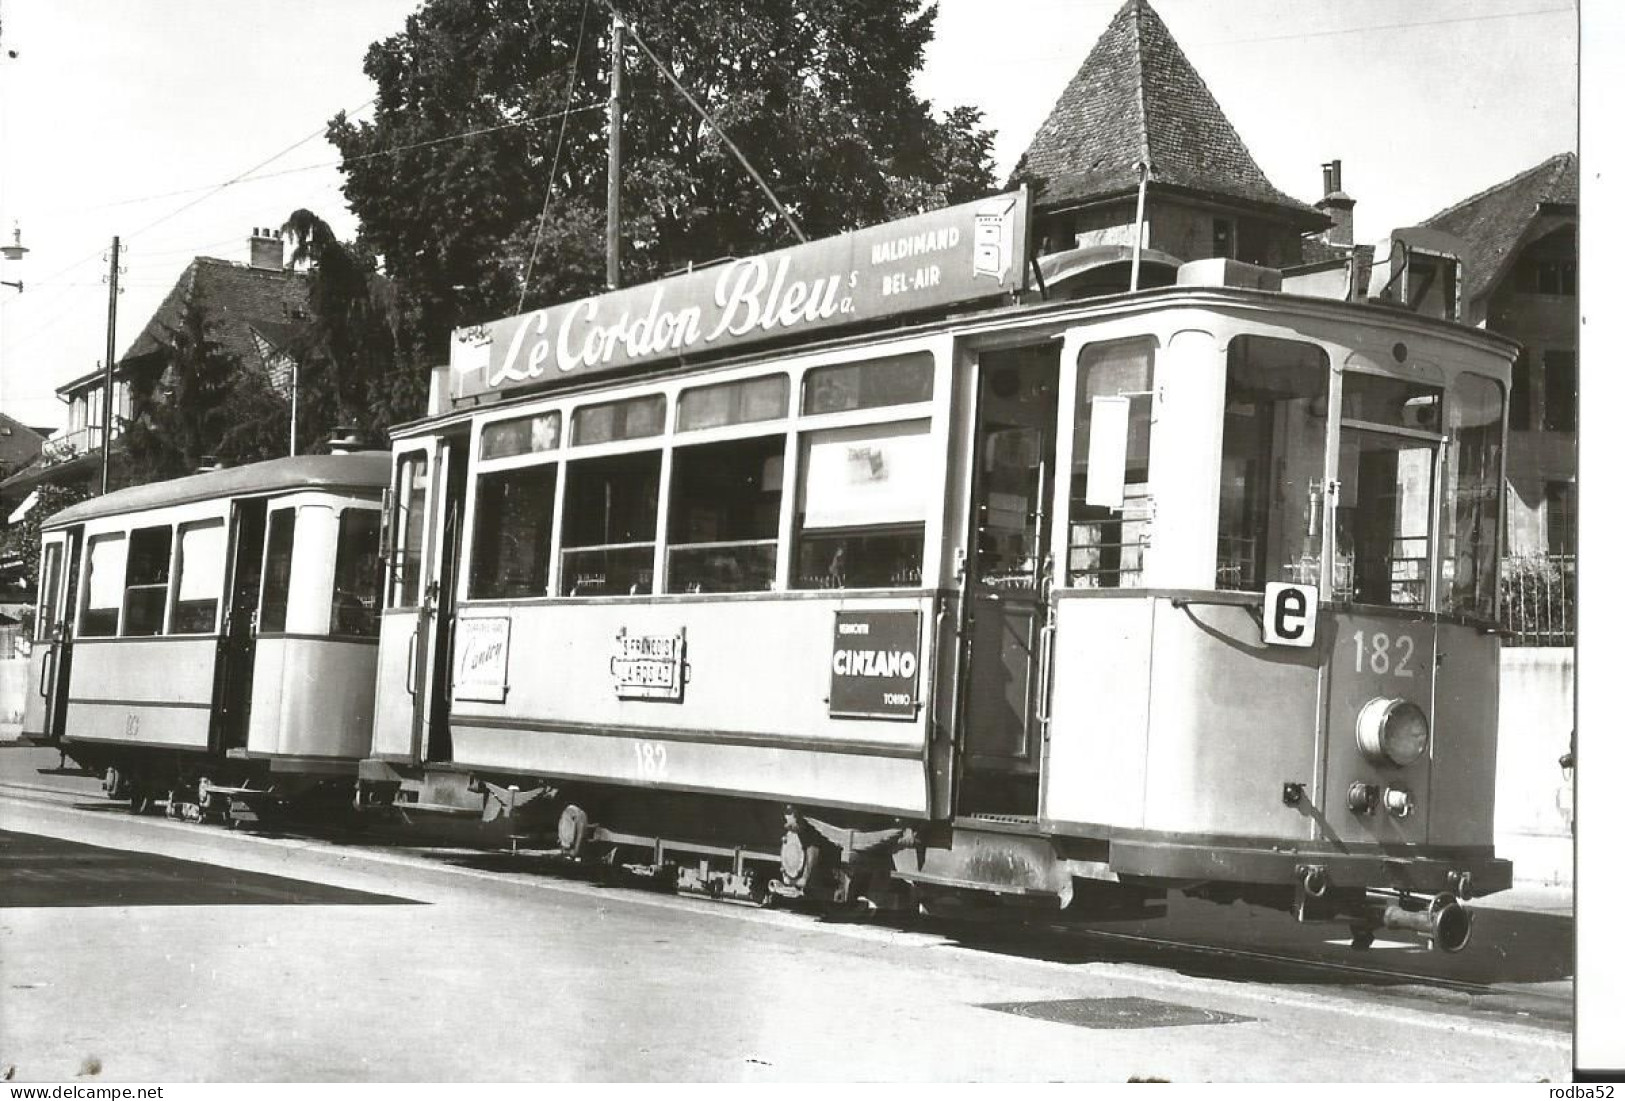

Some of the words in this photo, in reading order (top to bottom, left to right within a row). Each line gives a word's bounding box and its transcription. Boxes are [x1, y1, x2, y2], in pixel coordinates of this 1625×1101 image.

[871, 227, 960, 265] HALDIMAND
[882, 265, 941, 296] BEL-AIR
[490, 309, 549, 387] Le
[556, 286, 700, 373] Cordon
[705, 255, 842, 341] Bleu
[1274, 587, 1307, 640] e
[833, 649, 916, 678] CINZANO
[1353, 629, 1415, 678] 182
[634, 742, 668, 779] 182
